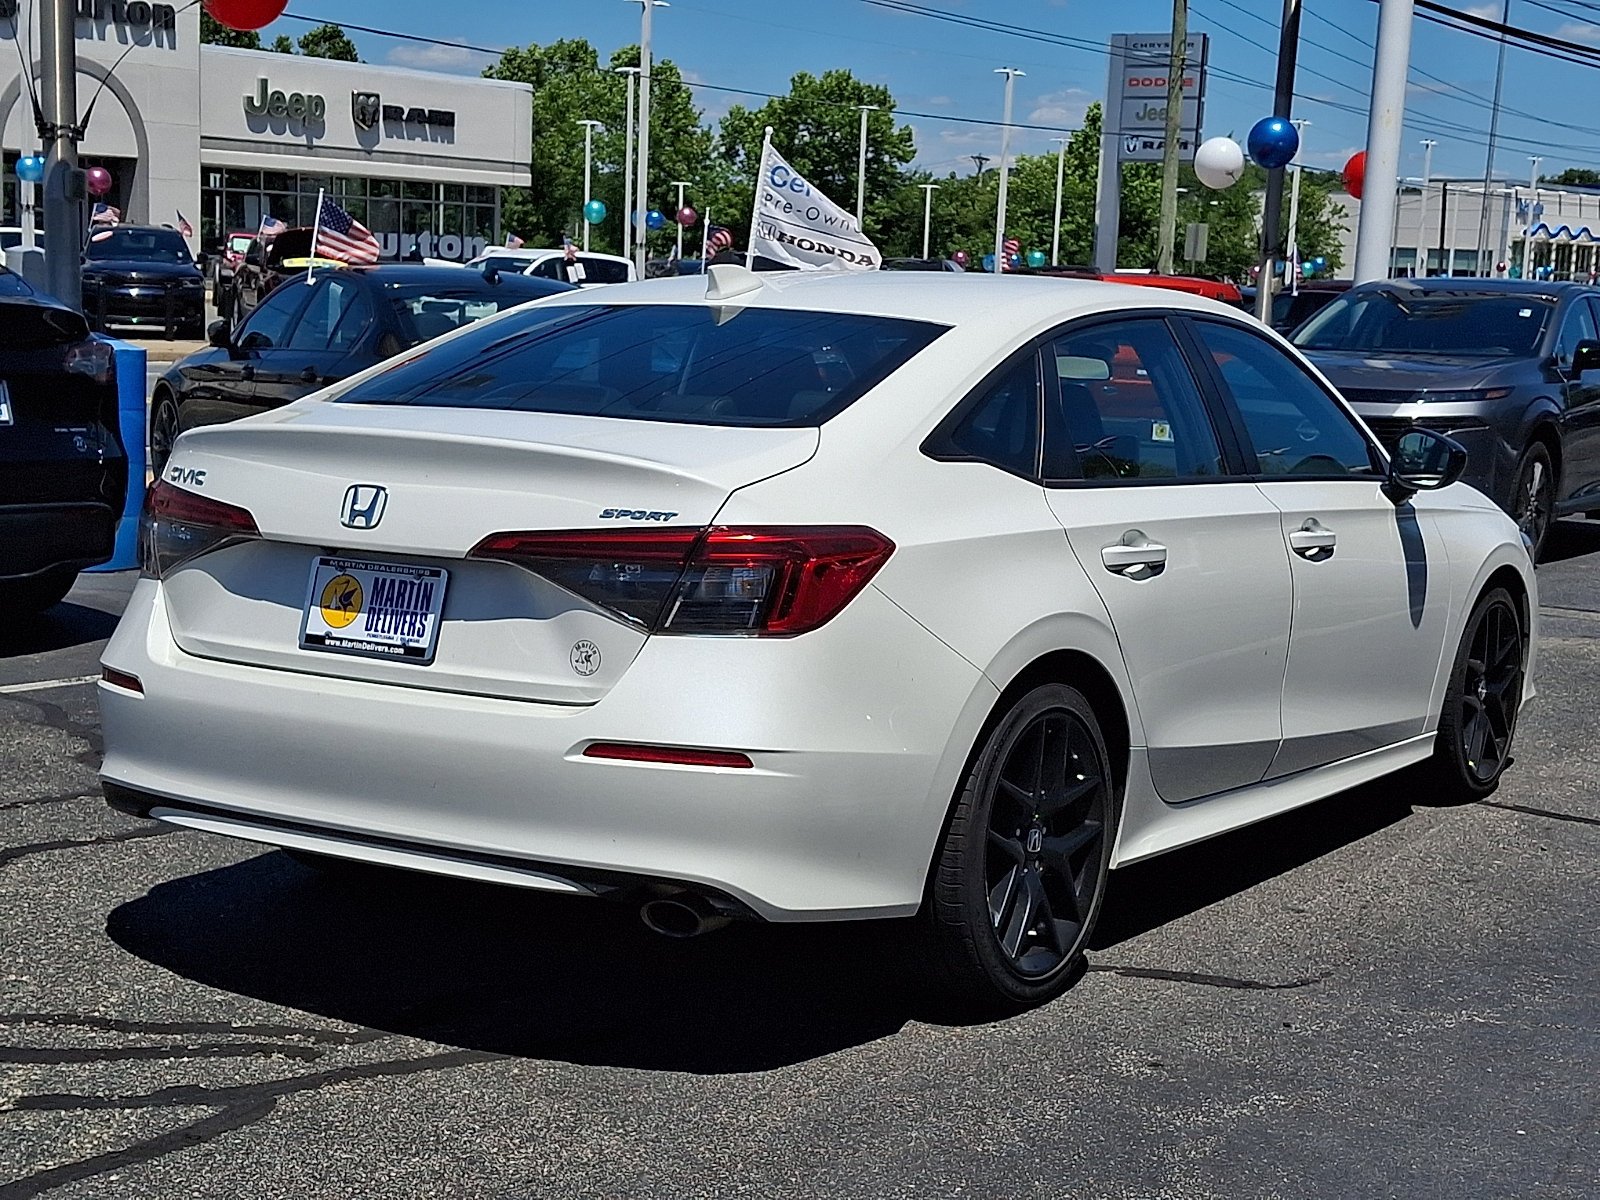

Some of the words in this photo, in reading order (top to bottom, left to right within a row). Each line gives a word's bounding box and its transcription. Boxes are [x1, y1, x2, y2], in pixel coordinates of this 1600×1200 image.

[75, 0, 176, 30] urton
[1128, 77, 1193, 87] DODE
[242, 76, 326, 128] Jeep
[382, 103, 456, 128] RAM
[1136, 103, 1168, 121] Jee
[373, 230, 487, 260] urton
[775, 229, 876, 267] HONDA
[170, 466, 207, 486] CIVIC
[598, 508, 679, 522] SPORT
[329, 559, 366, 570] MARTIN
[369, 576, 435, 613] MARTIN
[364, 607, 428, 638] DELIVERS
